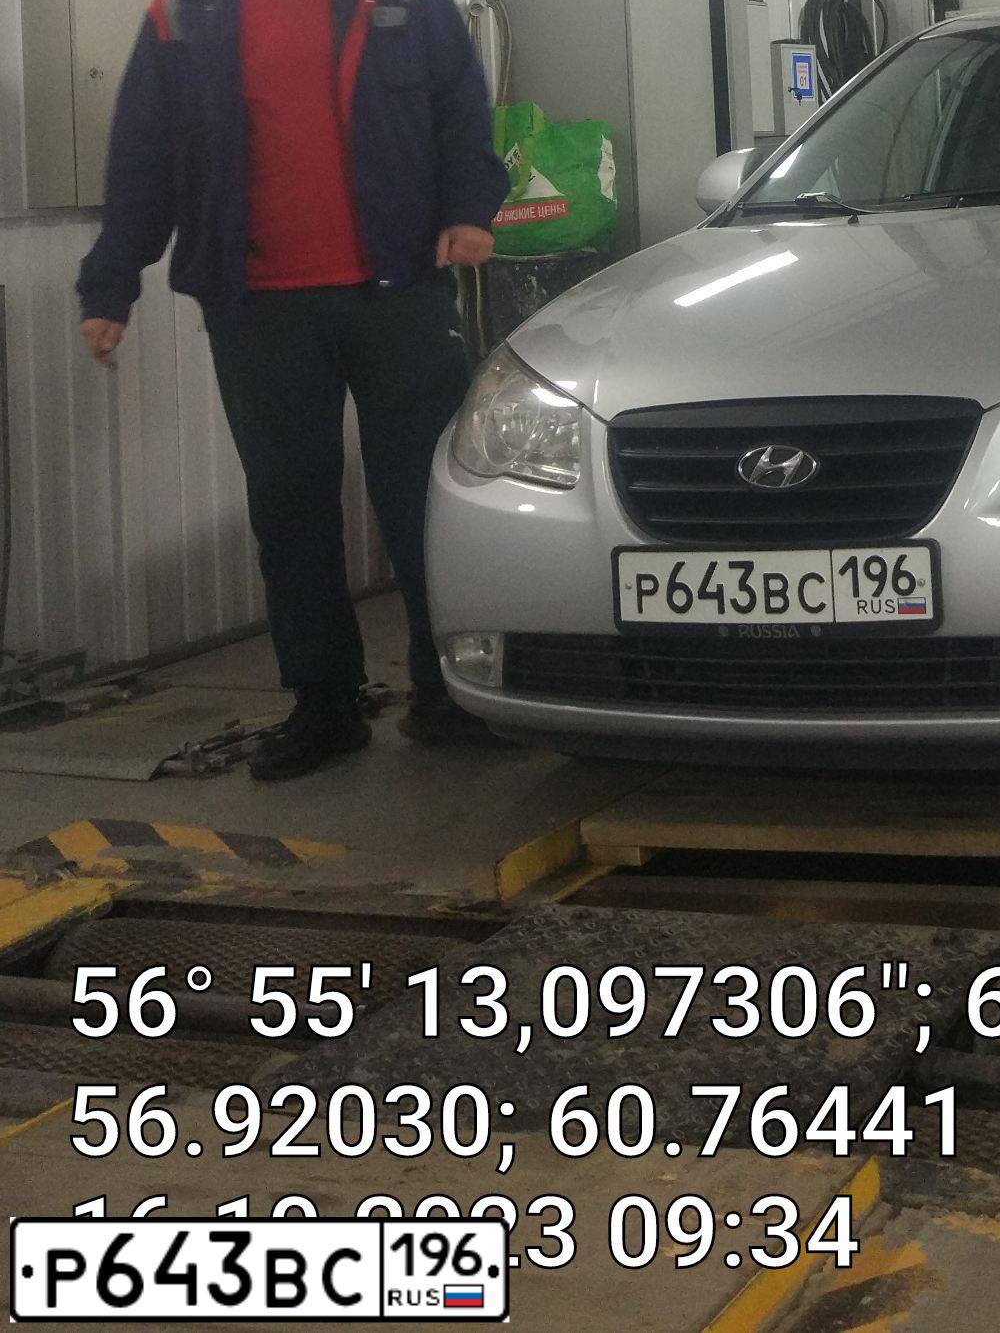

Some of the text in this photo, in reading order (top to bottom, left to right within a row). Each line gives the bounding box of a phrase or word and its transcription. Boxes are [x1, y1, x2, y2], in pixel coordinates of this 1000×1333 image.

[505, 206, 537, 221] НИЗКИЕ
[538, 203, 566, 218] ЦЕНЫ
[635, 554, 917, 615] Р643ВС 196
[856, 598, 896, 615] RUS
[737, 624, 800, 639] RUSSIA
